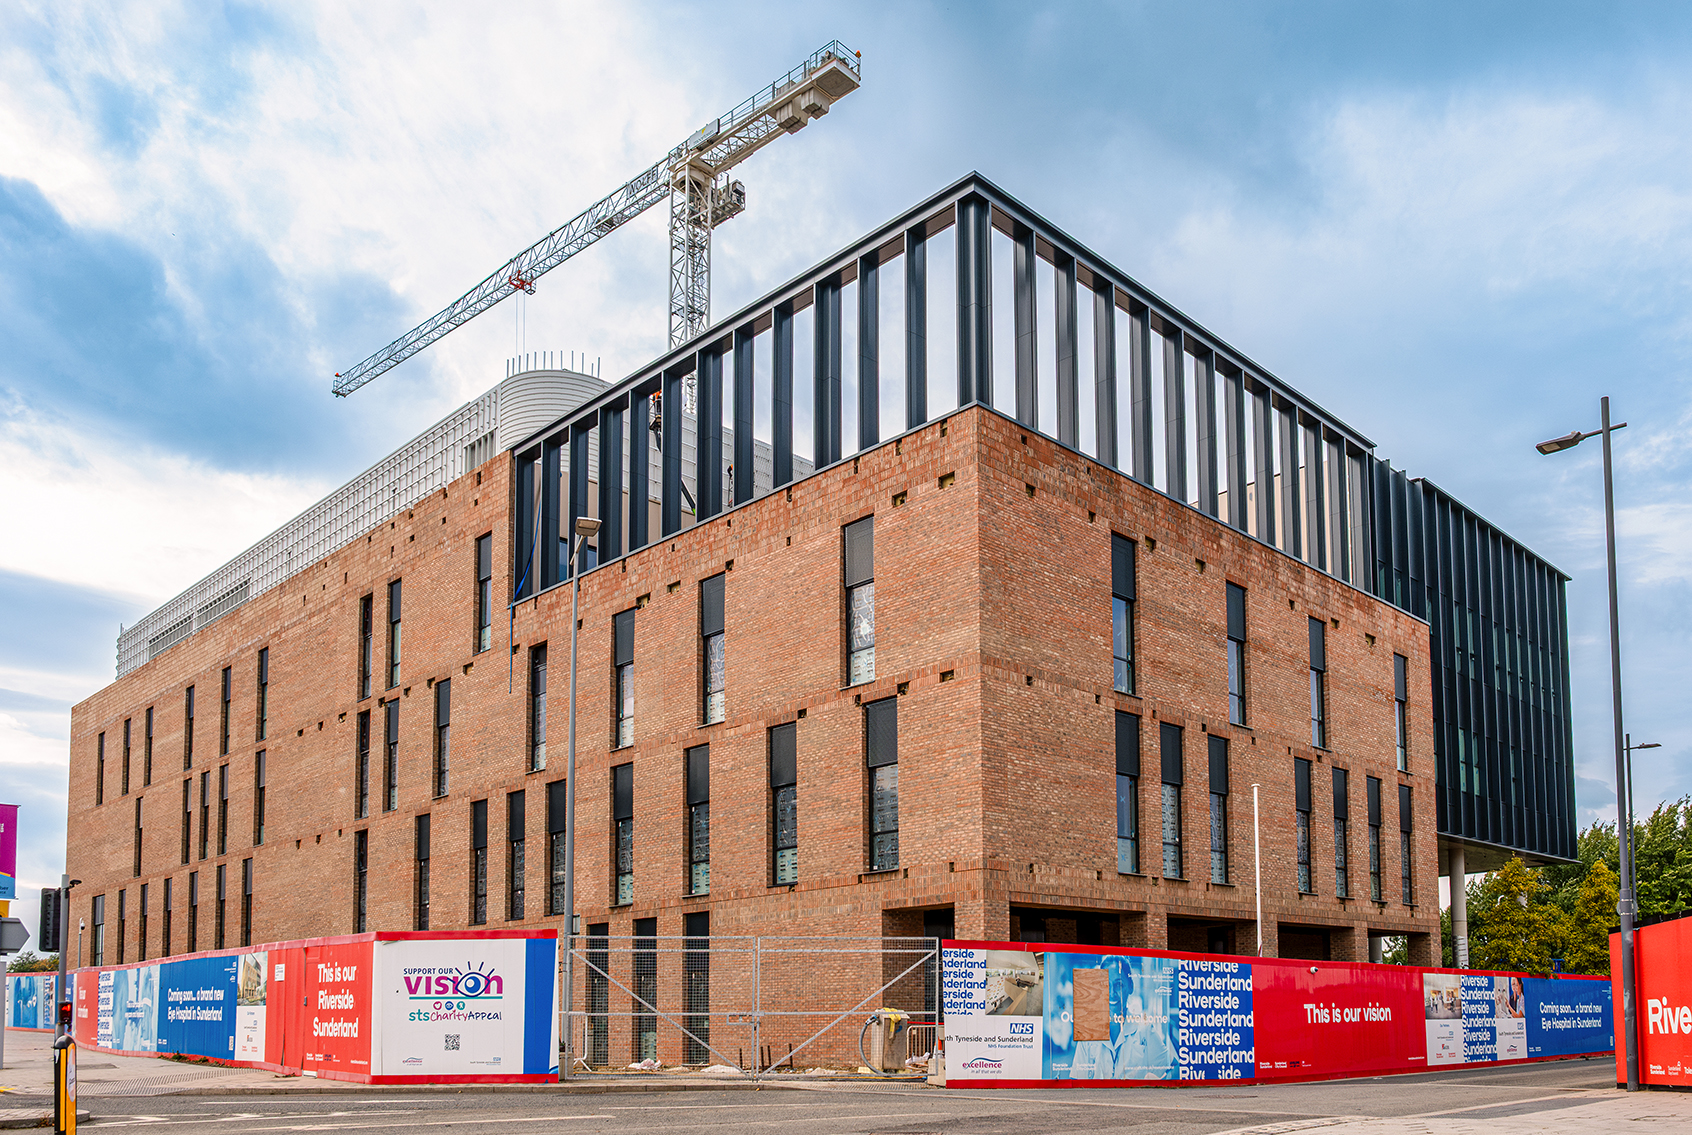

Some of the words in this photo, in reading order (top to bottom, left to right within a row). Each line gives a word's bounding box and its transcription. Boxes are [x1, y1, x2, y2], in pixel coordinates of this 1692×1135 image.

[318, 962, 333, 983] This
[335, 962, 341, 982] is
[343, 966, 357, 981] our
[1179, 959, 1239, 973] Riverside
[1178, 972, 1252, 991] Sunderland
[1460, 974, 1488, 987] Riverside
[168, 988, 182, 1004] Coming
[197, 990, 200, 1001] a
[200, 986, 214, 1001] brand
[214, 990, 224, 1000] new
[318, 989, 354, 1010] Riverside
[1179, 990, 1240, 1009] Riverside
[1460, 987, 1495, 1000] Sunderland
[176, 1006, 191, 1023] Hospital
[191, 1006, 196, 1020] in
[197, 1006, 222, 1021] Sunderland
[1304, 1002, 1330, 1024] This
[1332, 1002, 1341, 1023] is
[1343, 1008, 1361, 1022] our
[1363, 1002, 1391, 1022] vision
[1461, 1001, 1490, 1014] Riverside
[1540, 1002, 1559, 1016] Coming
[1575, 1005, 1579, 1013] a
[1579, 1002, 1592, 1013] brand
[1593, 1005, 1602, 1013] new
[1647, 996, 1692, 1034] Rive
[1114, 1013, 1124, 1023] to
[1126, 1012, 1168, 1023] welcome
[1179, 1009, 1254, 1027] Sunderland
[1462, 1014, 1496, 1027] Sunderland
[1542, 1018, 1551, 1031] Eye
[1552, 1017, 1571, 1031] Hospital
[1572, 1017, 1577, 1028] in
[1577, 1017, 1601, 1028] Sunderland
[313, 1017, 358, 1038] Sunderland
[1010, 1023, 1033, 1034] NHS
[1463, 1028, 1490, 1041] Riverside
[1179, 1028, 1240, 1046] Riverside
[1178, 1047, 1255, 1065] Sunderland
[1463, 1042, 1497, 1055] Sunderland
